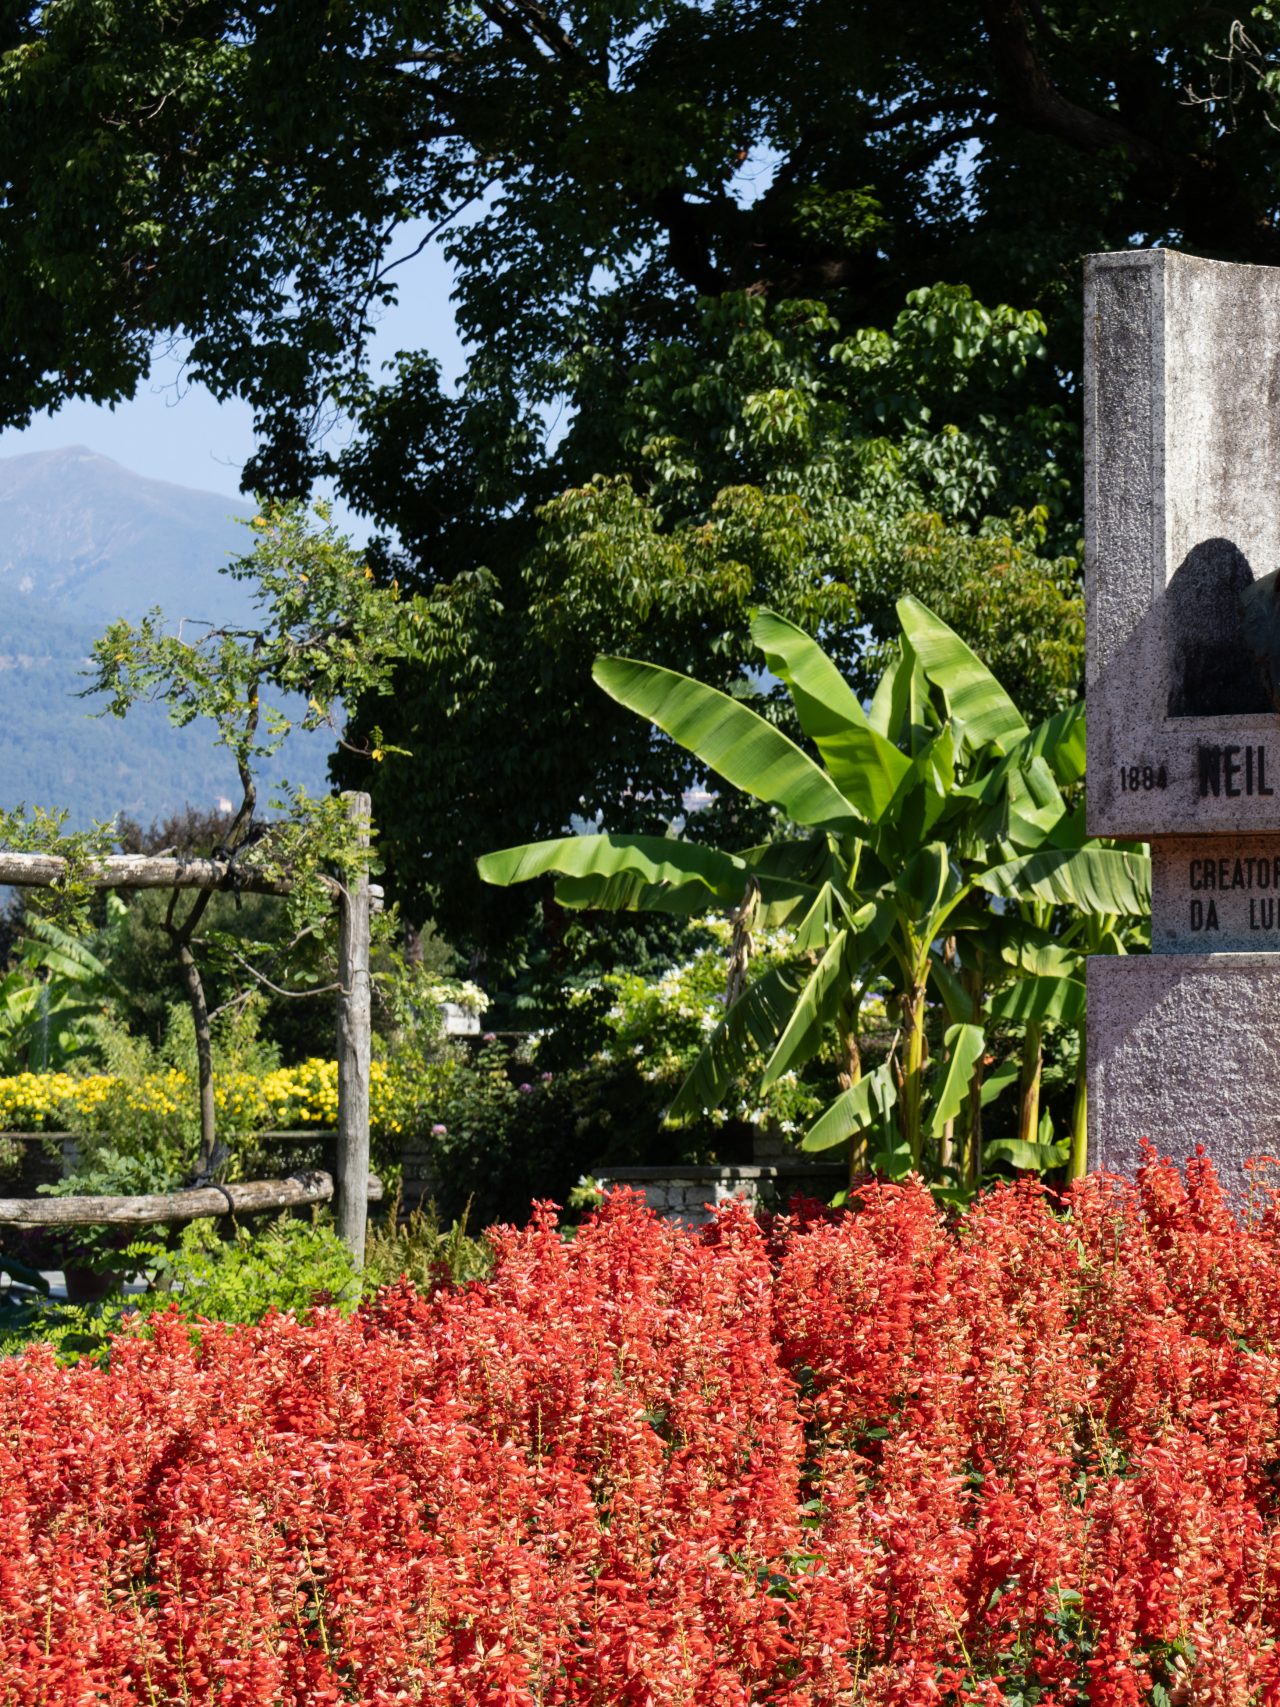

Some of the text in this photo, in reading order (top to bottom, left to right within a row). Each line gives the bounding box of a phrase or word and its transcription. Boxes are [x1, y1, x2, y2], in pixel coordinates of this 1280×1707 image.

[1120, 764, 1168, 792] 1884
[1199, 745, 1274, 797] NEIL
[1190, 900, 1220, 931] DA
